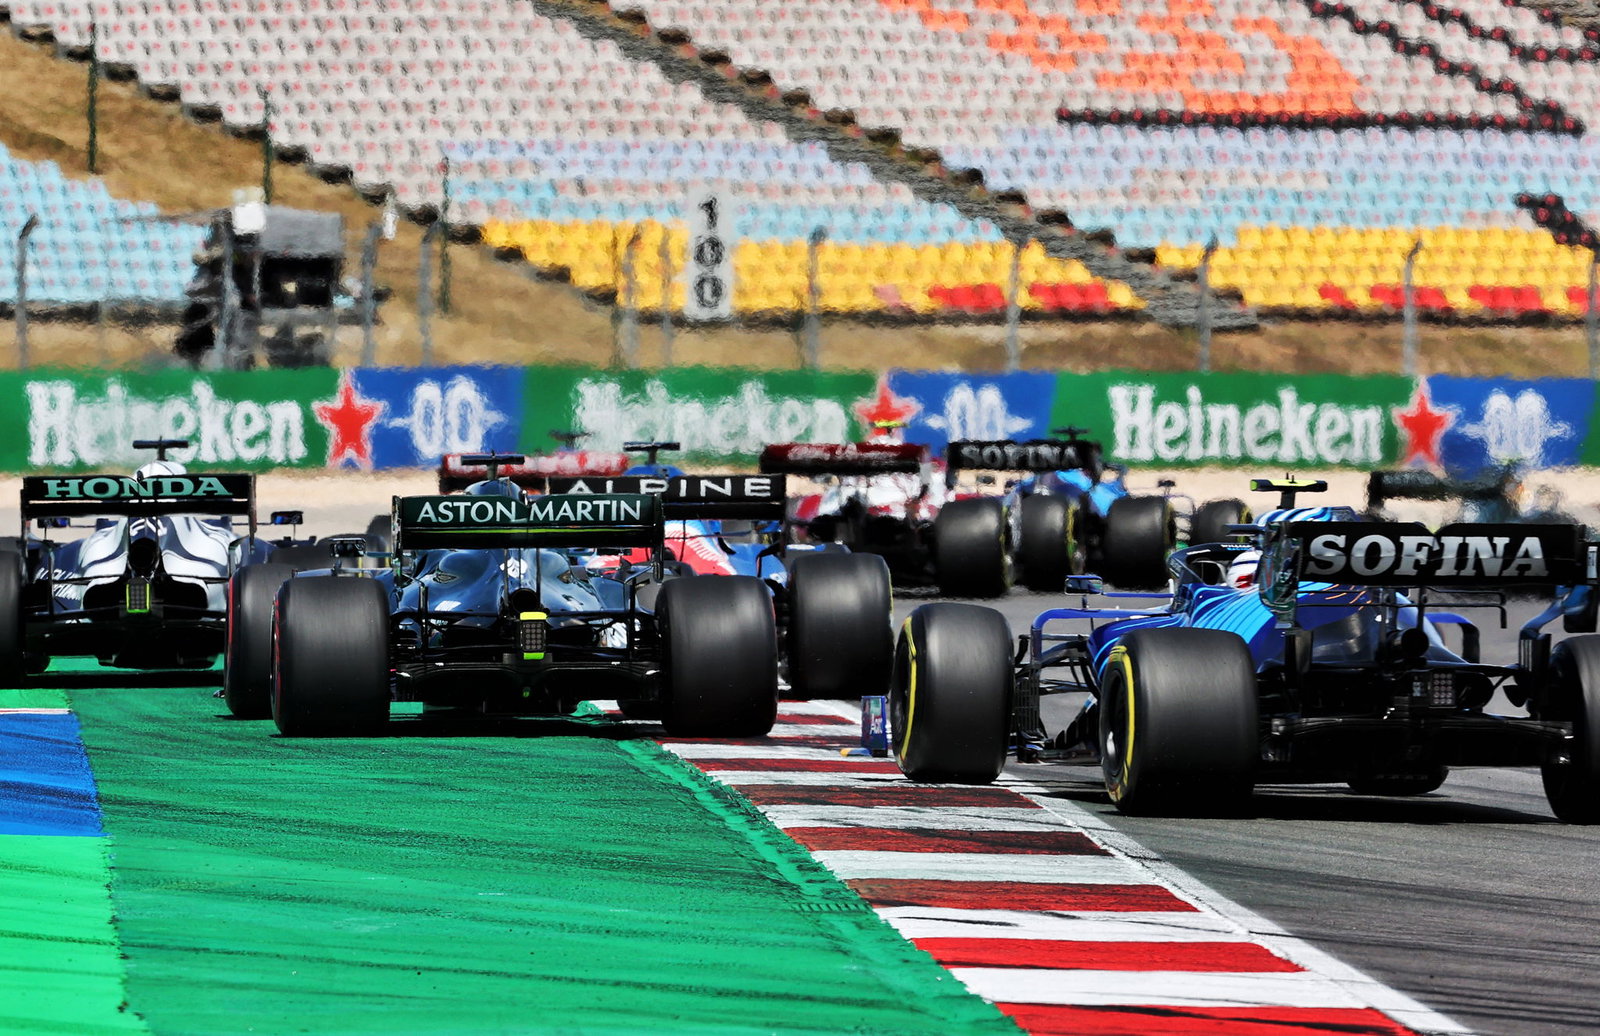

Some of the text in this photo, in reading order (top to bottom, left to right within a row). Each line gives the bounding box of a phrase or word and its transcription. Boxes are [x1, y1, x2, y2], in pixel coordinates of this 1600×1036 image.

[695, 194, 725, 309] 100
[1109, 385, 1385, 463] Heineken
[960, 443, 1080, 469] SOFINA
[43, 476, 233, 498] HONDA
[417, 500, 641, 523] ASTON MARTIN
[1304, 534, 1549, 577] SOFINA
